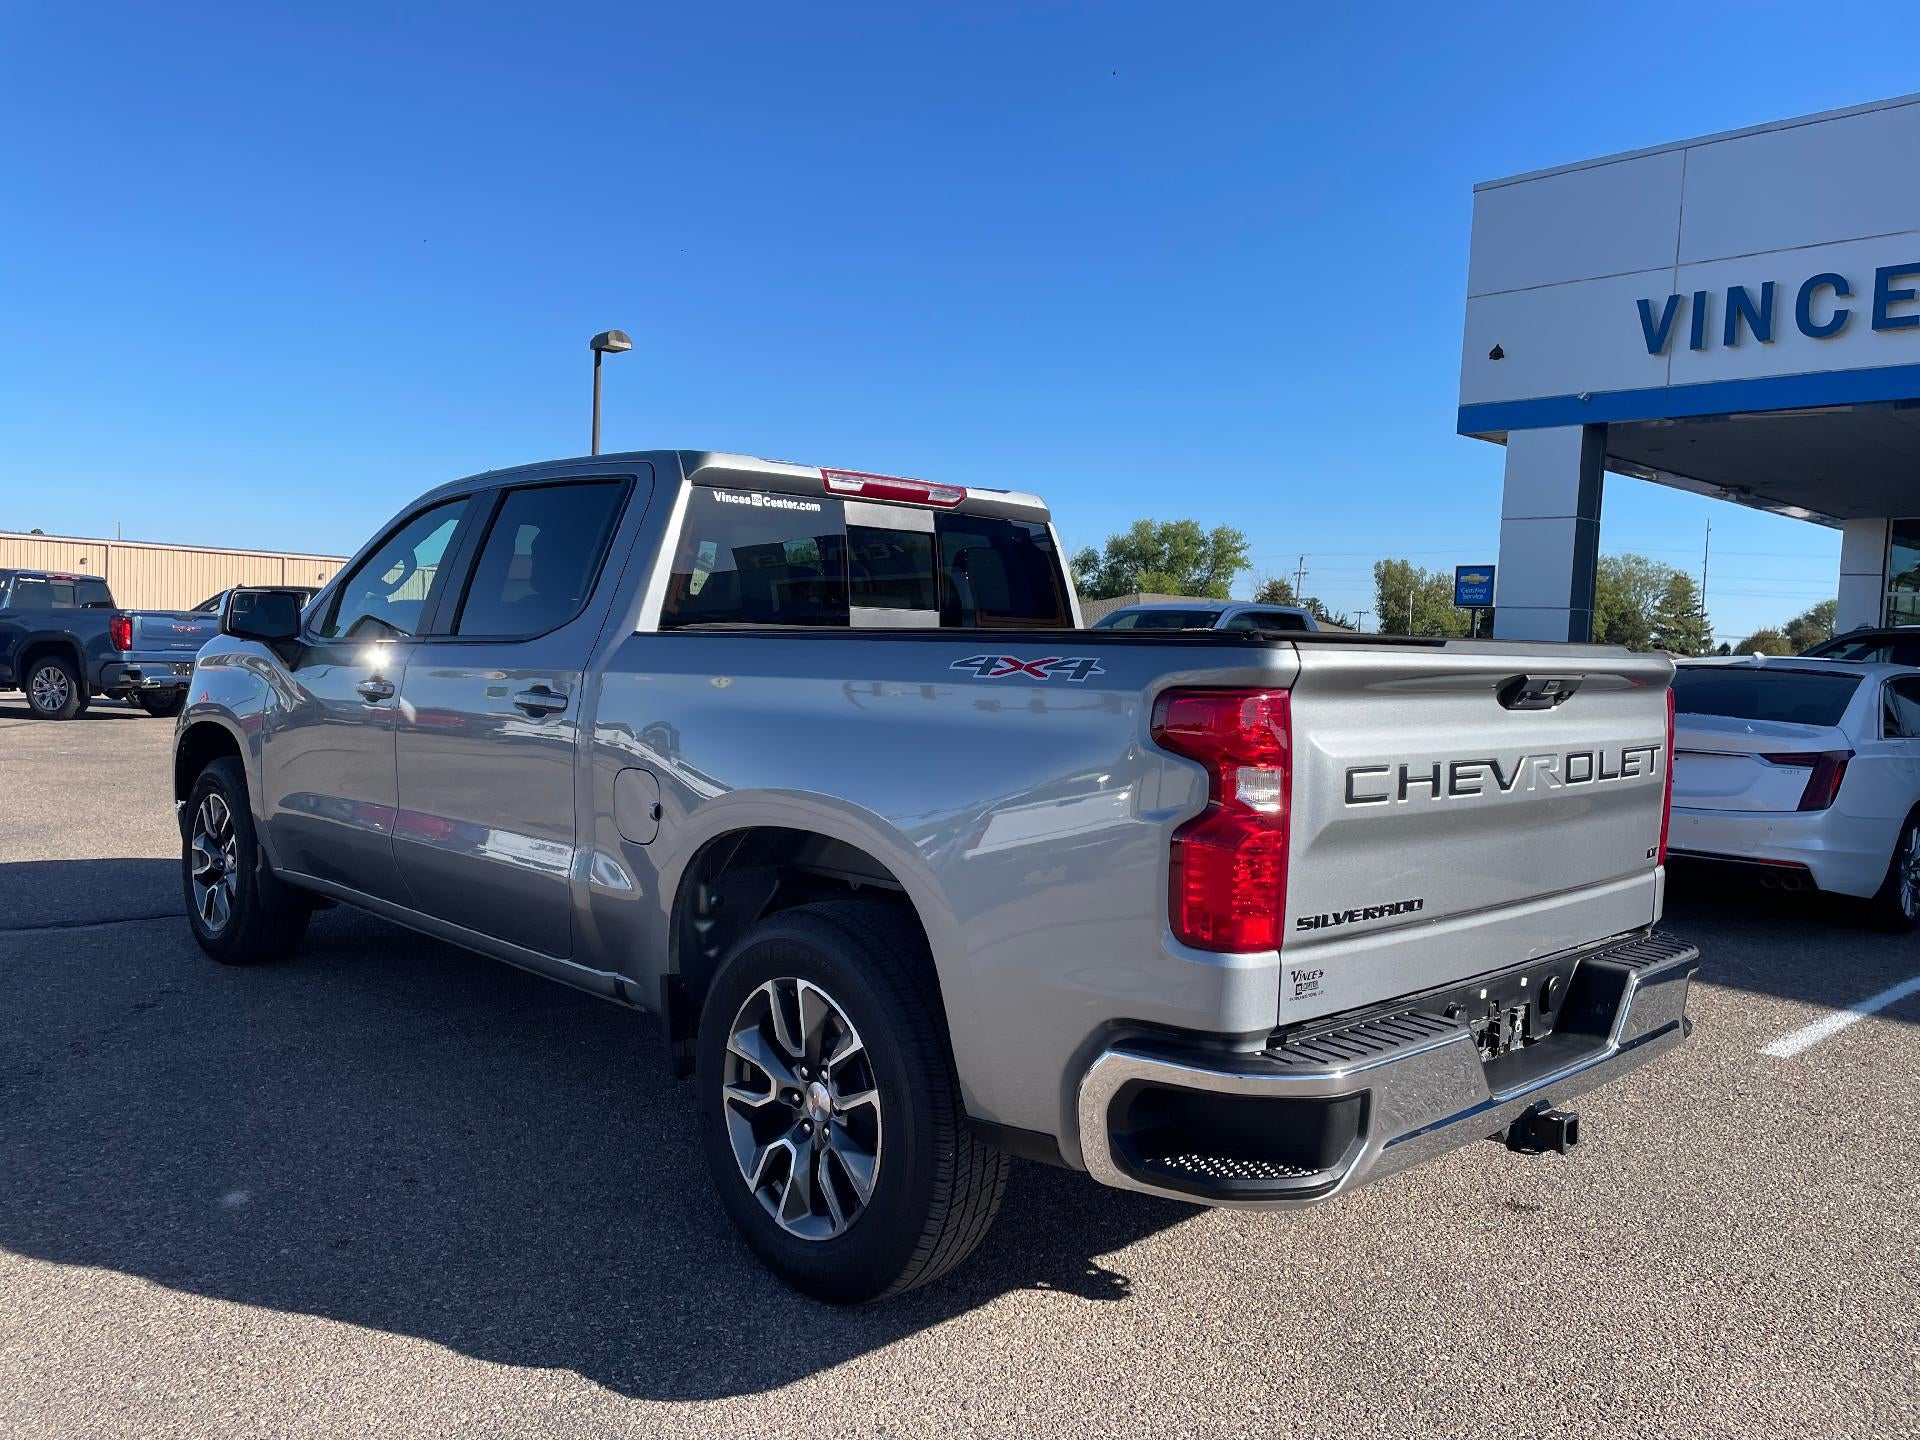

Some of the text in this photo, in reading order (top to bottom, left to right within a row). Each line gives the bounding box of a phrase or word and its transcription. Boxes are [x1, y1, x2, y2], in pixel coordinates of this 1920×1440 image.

[1636, 262, 1920, 355] VINCE
[1344, 744, 1663, 807] CHEVROLET
[1646, 846, 1658, 860] LT
[1296, 898, 1424, 931] SILVERADO
